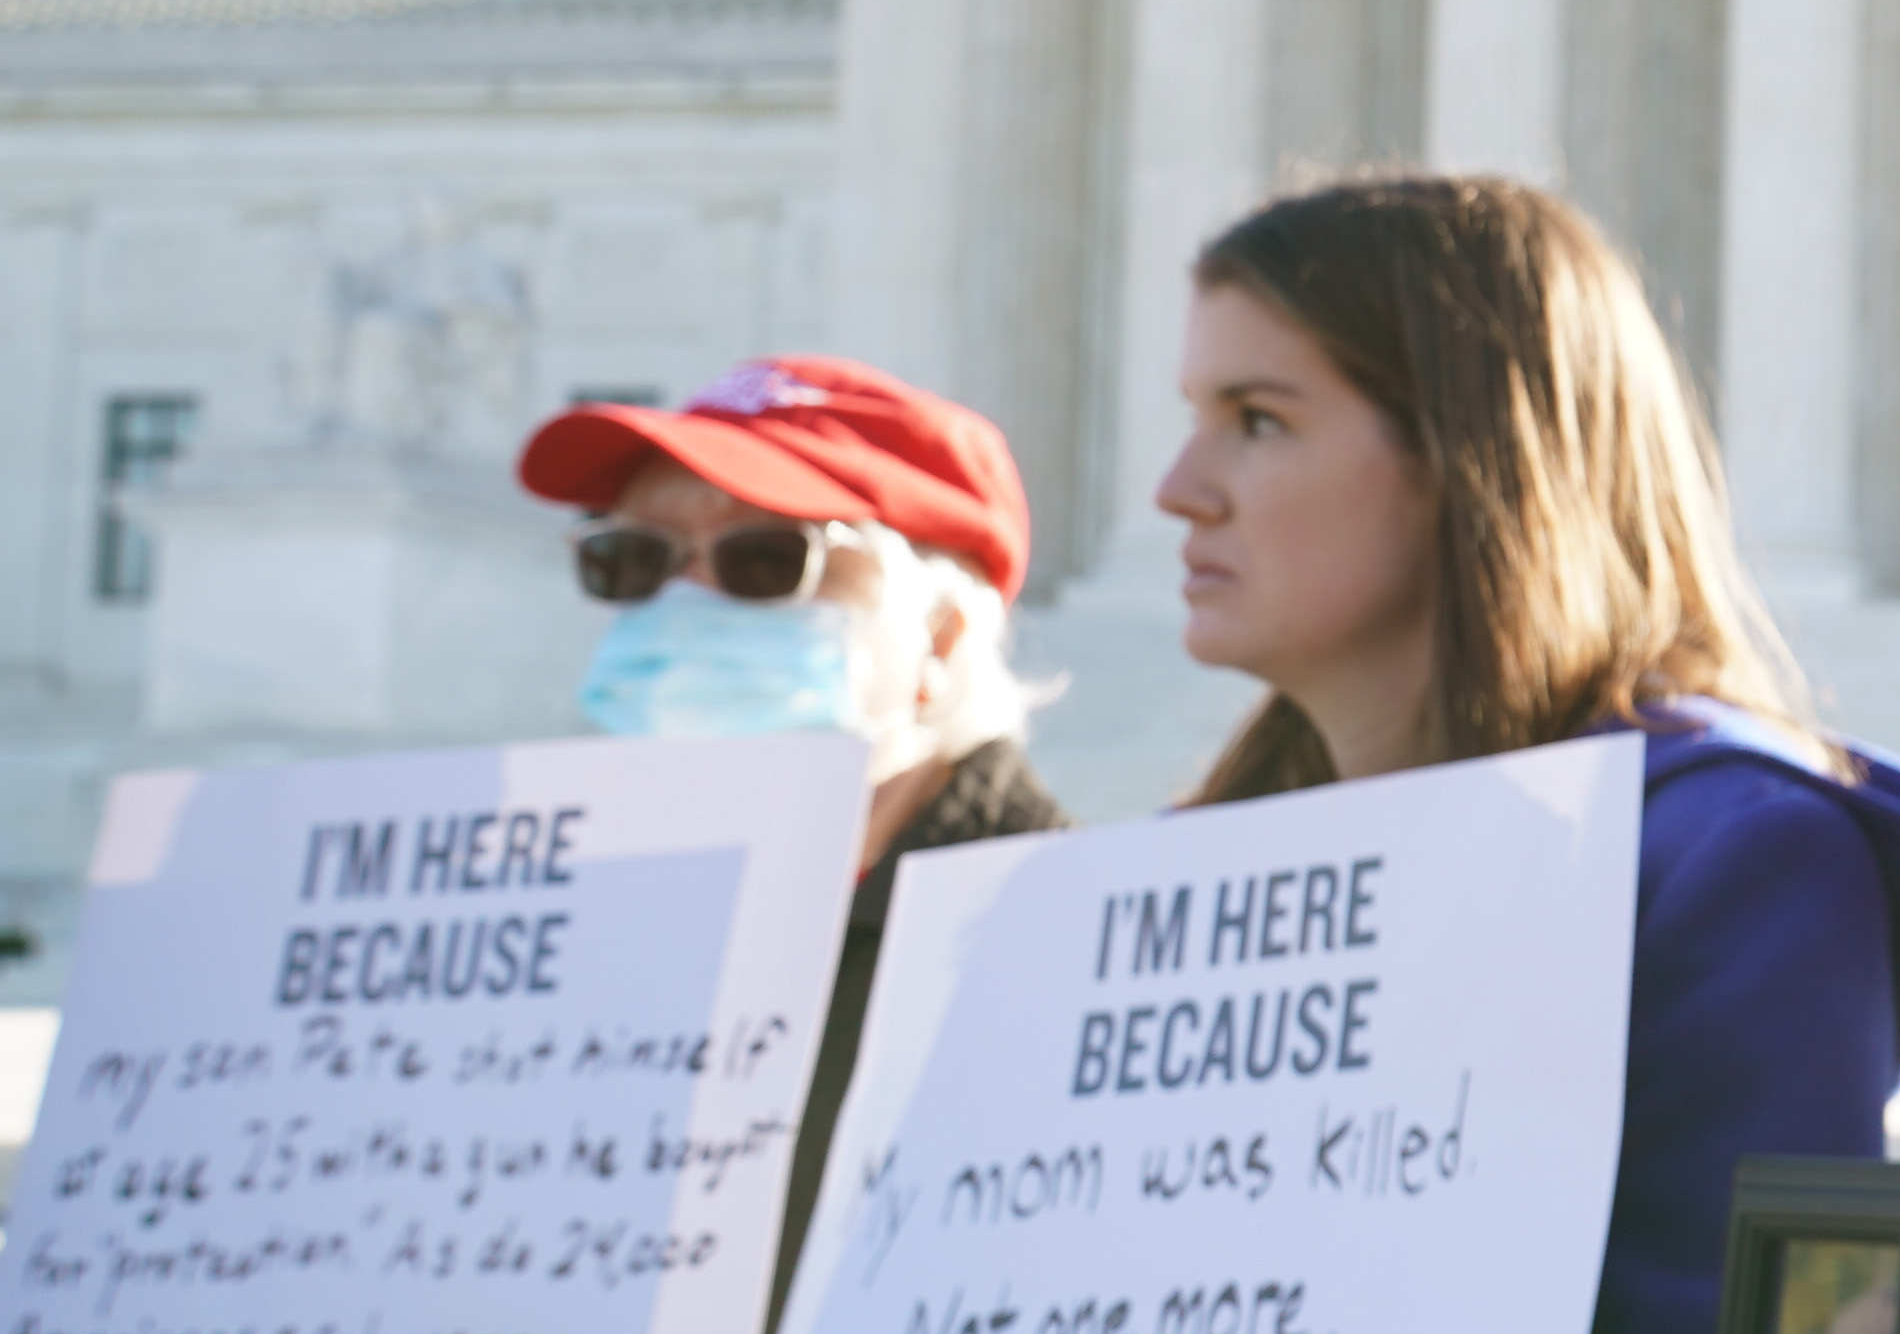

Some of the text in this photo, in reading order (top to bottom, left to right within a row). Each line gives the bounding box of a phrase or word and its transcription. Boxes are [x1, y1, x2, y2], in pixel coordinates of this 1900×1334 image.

[300, 806, 587, 904] I'M HERE
[275, 913, 572, 1007] BECAUSE
[1095, 856, 1386, 982] I'M HERE
[573, 1012, 788, 1079] himself
[1070, 977, 1383, 1098] BECAUSE
[565, 1117, 618, 1179] he
[940, 1139, 1106, 1227] mom
[1140, 1127, 1274, 1204] was
